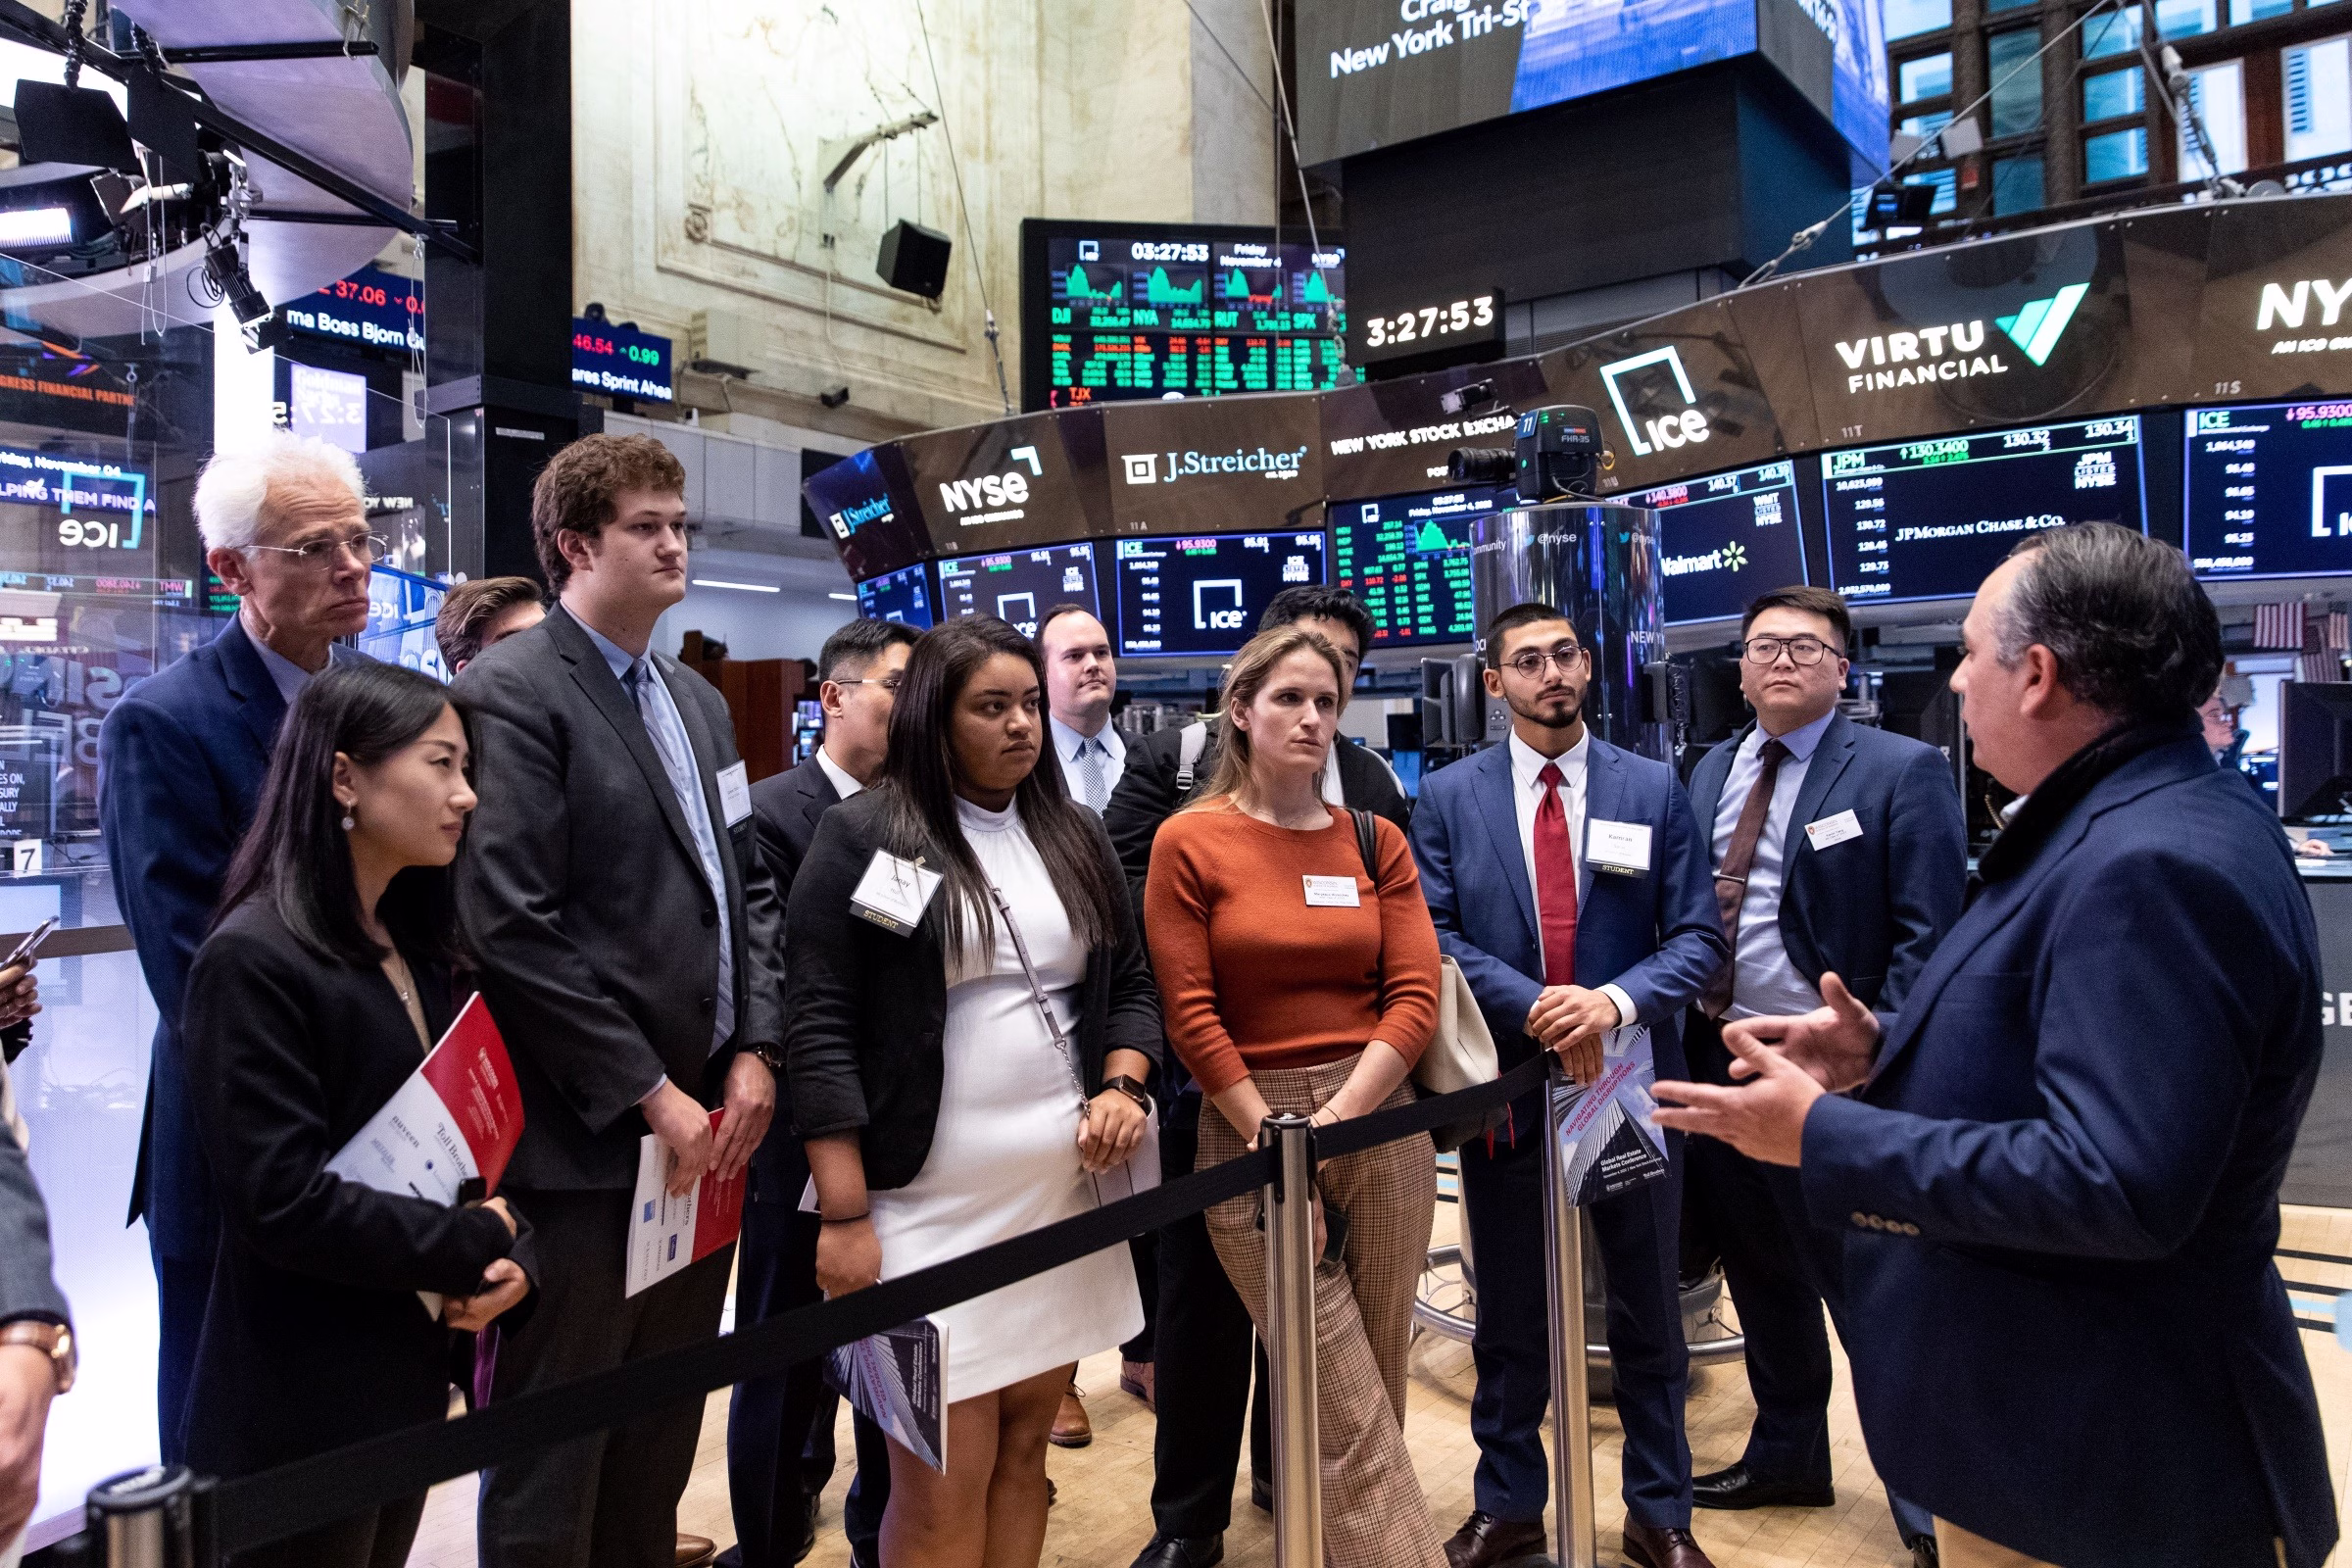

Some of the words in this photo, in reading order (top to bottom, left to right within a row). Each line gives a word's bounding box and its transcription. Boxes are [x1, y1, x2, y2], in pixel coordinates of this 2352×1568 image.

[1330, 47, 1390, 78] New
[1392, 19, 1454, 59] York
[1131, 242, 1208, 262] 03:27:53
[1233, 243, 1268, 258] Friday
[1219, 255, 1273, 269] November
[1273, 257, 1282, 268] 4
[335, 279, 387, 307] 37.06
[1052, 307, 1071, 324] DJI
[1133, 309, 1159, 325] NYA
[1214, 311, 1239, 328] RUT
[1293, 313, 1317, 330] SPX
[1366, 295, 1494, 348] 3:27:53
[286, 309, 315, 329] ma
[318, 312, 361, 338] Boss
[362, 320, 405, 345] Bjorn
[572, 333, 614, 356] 46.54
[628, 345, 661, 367] 0.99
[1836, 319, 1985, 369] VIRTU
[1848, 354, 2009, 394] FINANCIAL
[601, 371, 640, 391] Sprint
[640, 379, 672, 400] Ahea
[1069, 387, 1092, 401] TJX
[1522, 416, 1534, 434] 11
[2198, 411, 2230, 429] ICE
[2295, 404, 2352, 421] 95.9300
[1330, 437, 1365, 456] NEW
[1365, 429, 1409, 451] YORK
[1409, 421, 1462, 445] STOCK
[1560, 434, 1591, 444] FHR-35
[1833, 452, 1866, 470] JPM
[1909, 440, 1970, 460] 130.3400
[2003, 430, 2050, 448] 130.32
[2084, 419, 2134, 438] 130.34
[34, 455, 102, 476] November
[103, 464, 122, 477] 04
[1162, 446, 1308, 483] J.Streicher
[2076, 451, 2113, 466] JPM
[2074, 464, 2117, 477] LISTED
[2075, 473, 2117, 490] NYSE
[51, 487, 99, 507] THEM
[101, 493, 141, 511] FIND
[143, 498, 156, 512] A
[1753, 492, 1780, 506] WMT
[1432, 504, 1467, 515] November
[1755, 513, 1783, 527] NYSE
[1894, 523, 1976, 542] JPMORGAN
[1976, 519, 2024, 534] CHASE
[2025, 515, 2038, 530] &
[2038, 514, 2067, 528] CO.
[1124, 541, 1144, 554] ICE
[1181, 538, 1217, 550] 95.9300
[1473, 539, 1507, 556] ommunity
[1537, 531, 1577, 546] @nyse
[1630, 630, 1654, 644] NEW
[21, 848, 35, 874] 7
[1601, 864, 1635, 875] STUDENT
[862, 909, 900, 930] STUDENT
[1565, 1094, 1597, 1137] NAVIGATING
[1596, 1062, 1624, 1095] THROUGH
[1577, 1104, 1599, 1132] GLOBAL
[1597, 1060, 1636, 1105] DISRUPTIONS
[391, 1114, 419, 1150] nuveen
[448, 1144, 469, 1176] Brothe
[1601, 1156, 1616, 1166] Global
[1616, 1153, 1627, 1162] Real
[1627, 1150, 1642, 1158] Estate
[1601, 1162, 1621, 1172] Markets
[1621, 1154, 1647, 1167] Conference
[685, 1193, 694, 1226] others
